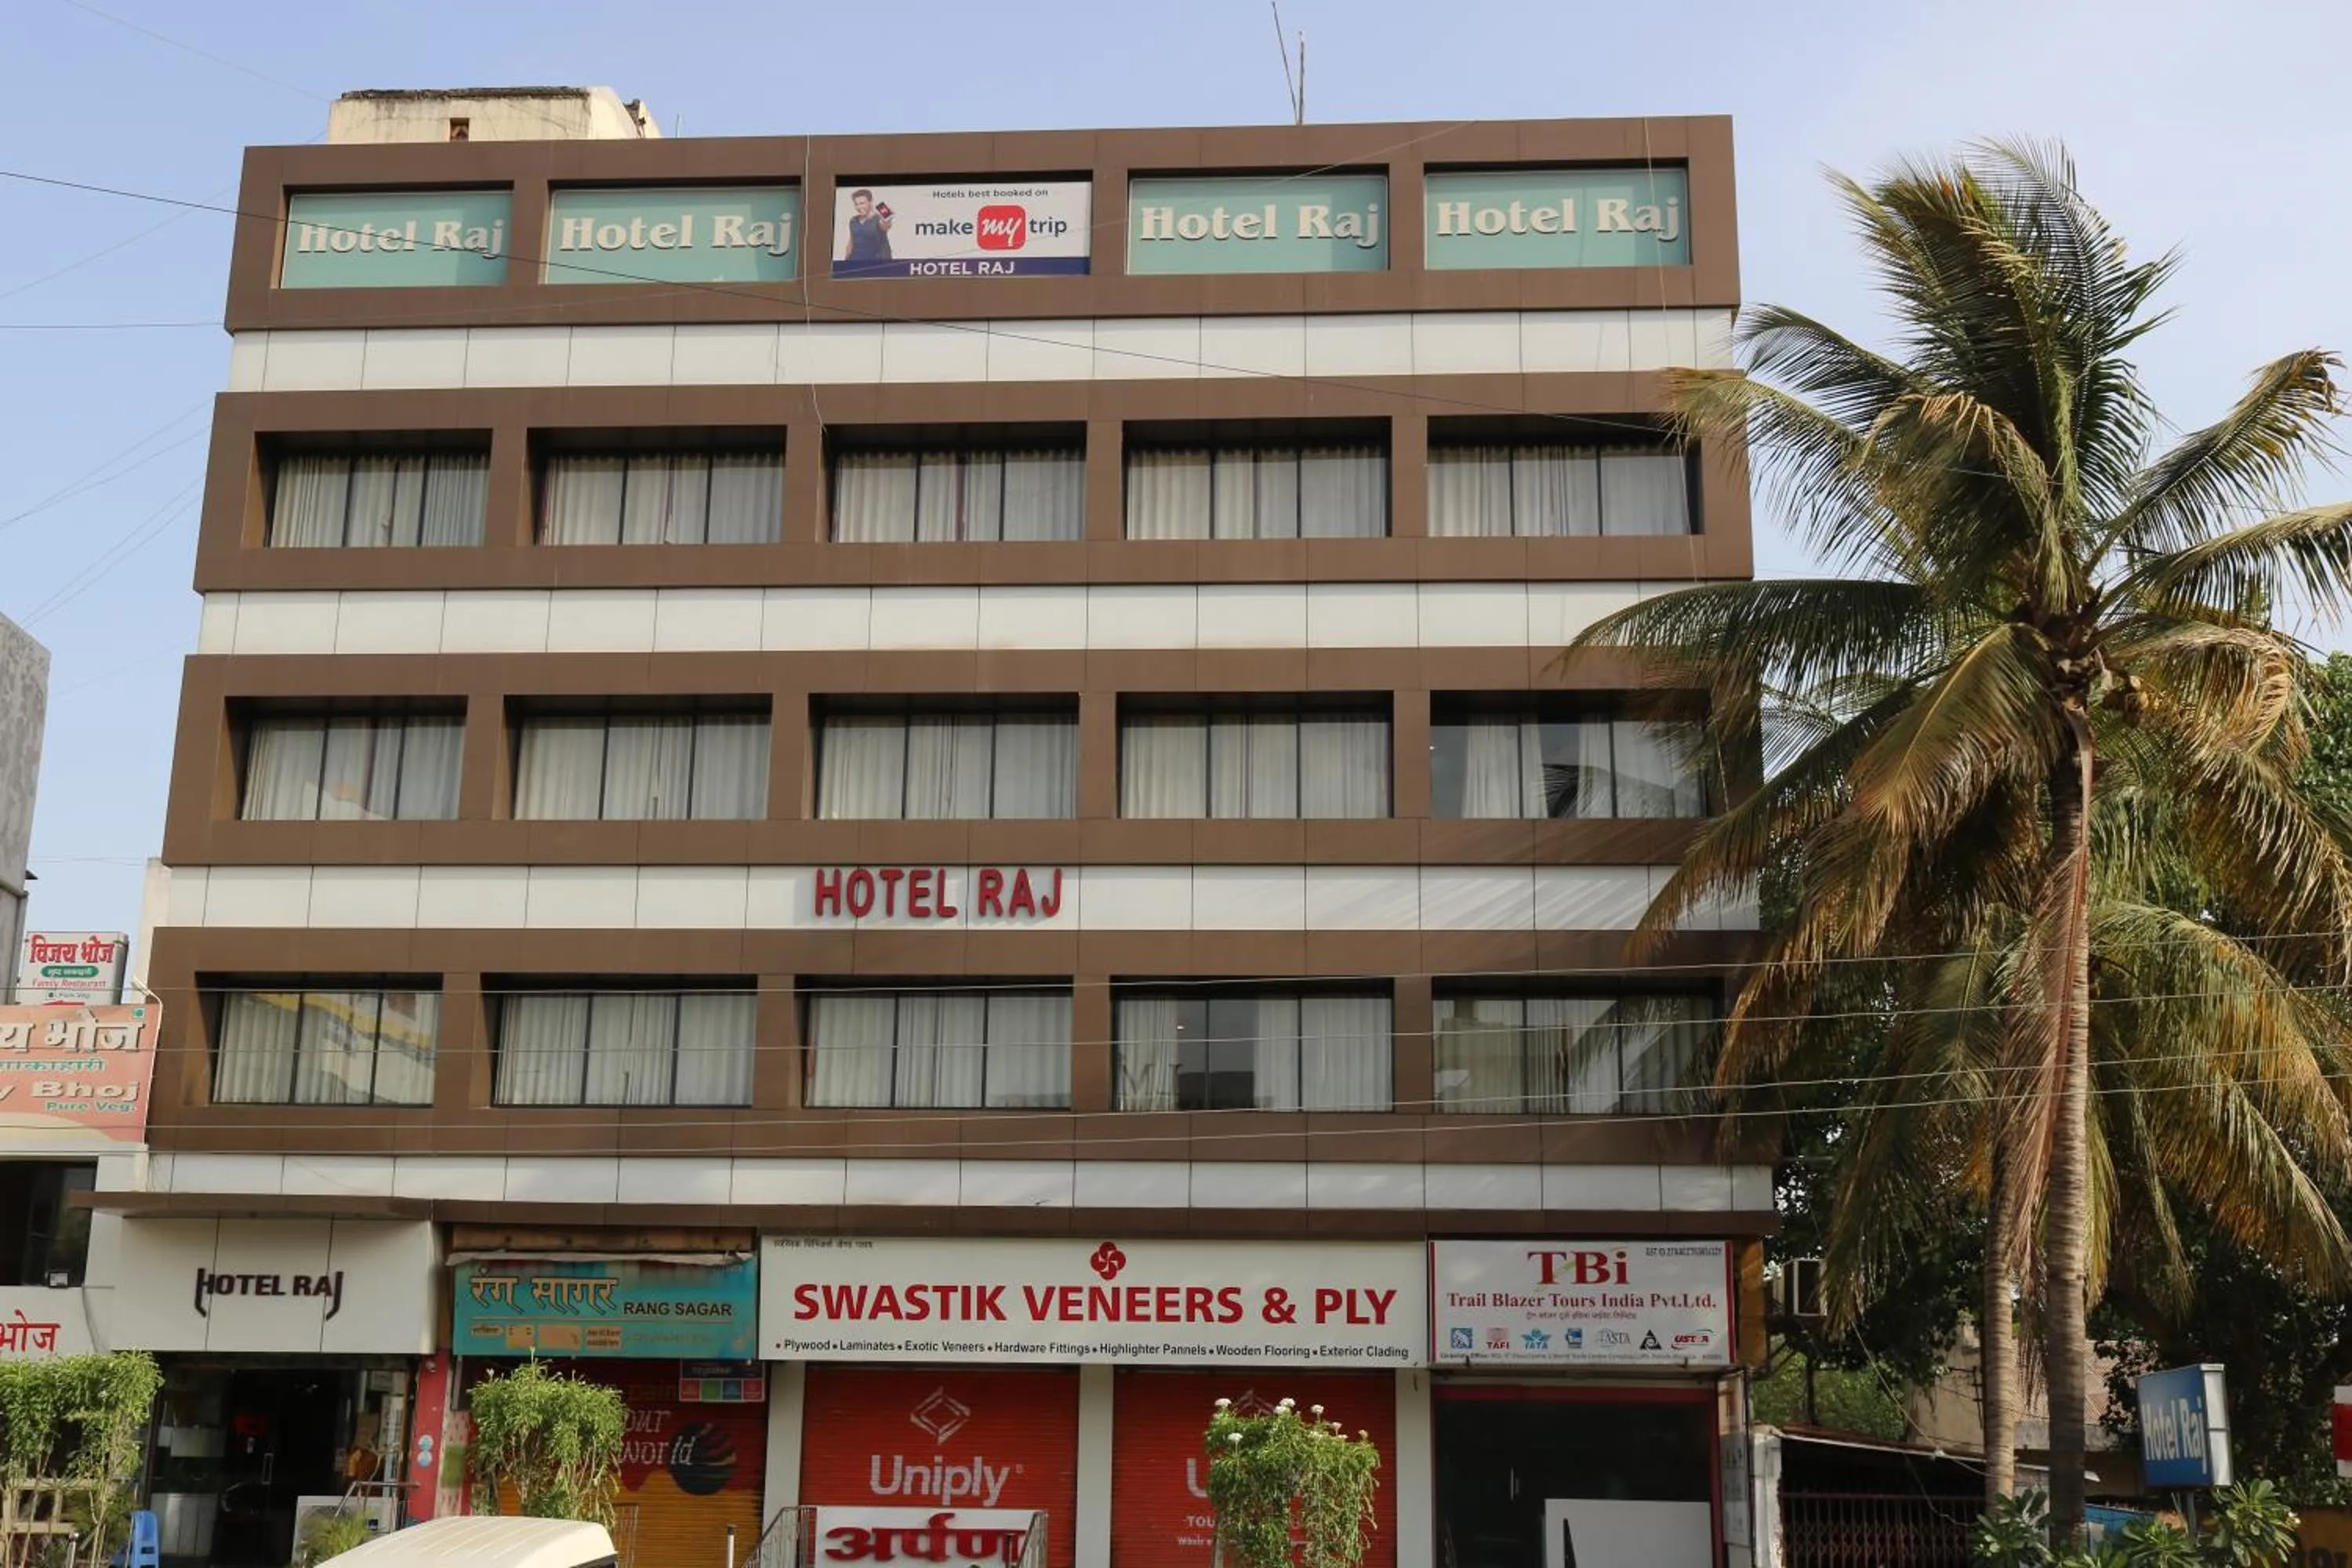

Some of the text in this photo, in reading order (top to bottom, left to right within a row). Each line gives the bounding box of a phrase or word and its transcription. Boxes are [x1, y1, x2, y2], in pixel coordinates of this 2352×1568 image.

[932, 190, 965, 198] Hotels
[968, 189, 990, 198] best
[993, 188, 1033, 198] booked
[297, 219, 504, 258] Hotel Raj
[559, 212, 793, 256] Hotel Raj
[915, 216, 1067, 247] make my trip
[1141, 203, 1380, 249] Hotel Raj
[1436, 197, 1680, 242] Hotel Raj
[910, 261, 1015, 275] HOTEL RAJ
[815, 868, 1062, 918] HOTEL RAJ
[29, 934, 114, 964] विजय भोज
[45, 1007, 146, 1053] भोज
[31, 1080, 141, 1102] Bhoj
[46, 1101, 136, 1113] Pure Veg.
[1526, 1249, 1630, 1285] TBi
[194, 1268, 343, 1321] HOTEL RAJ
[470, 1266, 620, 1316] रंग सागर
[624, 1302, 733, 1317] RANG SAGAR
[793, 1283, 1398, 1325] SWASTIK VENEERS & PLY
[1447, 1293, 1717, 1309] Trail Blazer Tours India Pvt.Ltd.
[784, 1339, 1409, 1359] Plywood Laminates Exotic Veneers Hardware Fittings Highlighter Pannels Wooden Flooring Exterior Clading
[2141, 1396, 2207, 1475] Hotel Raj
[869, 1454, 1011, 1507] Uniply
[825, 1512, 1027, 1563] अर्पण
